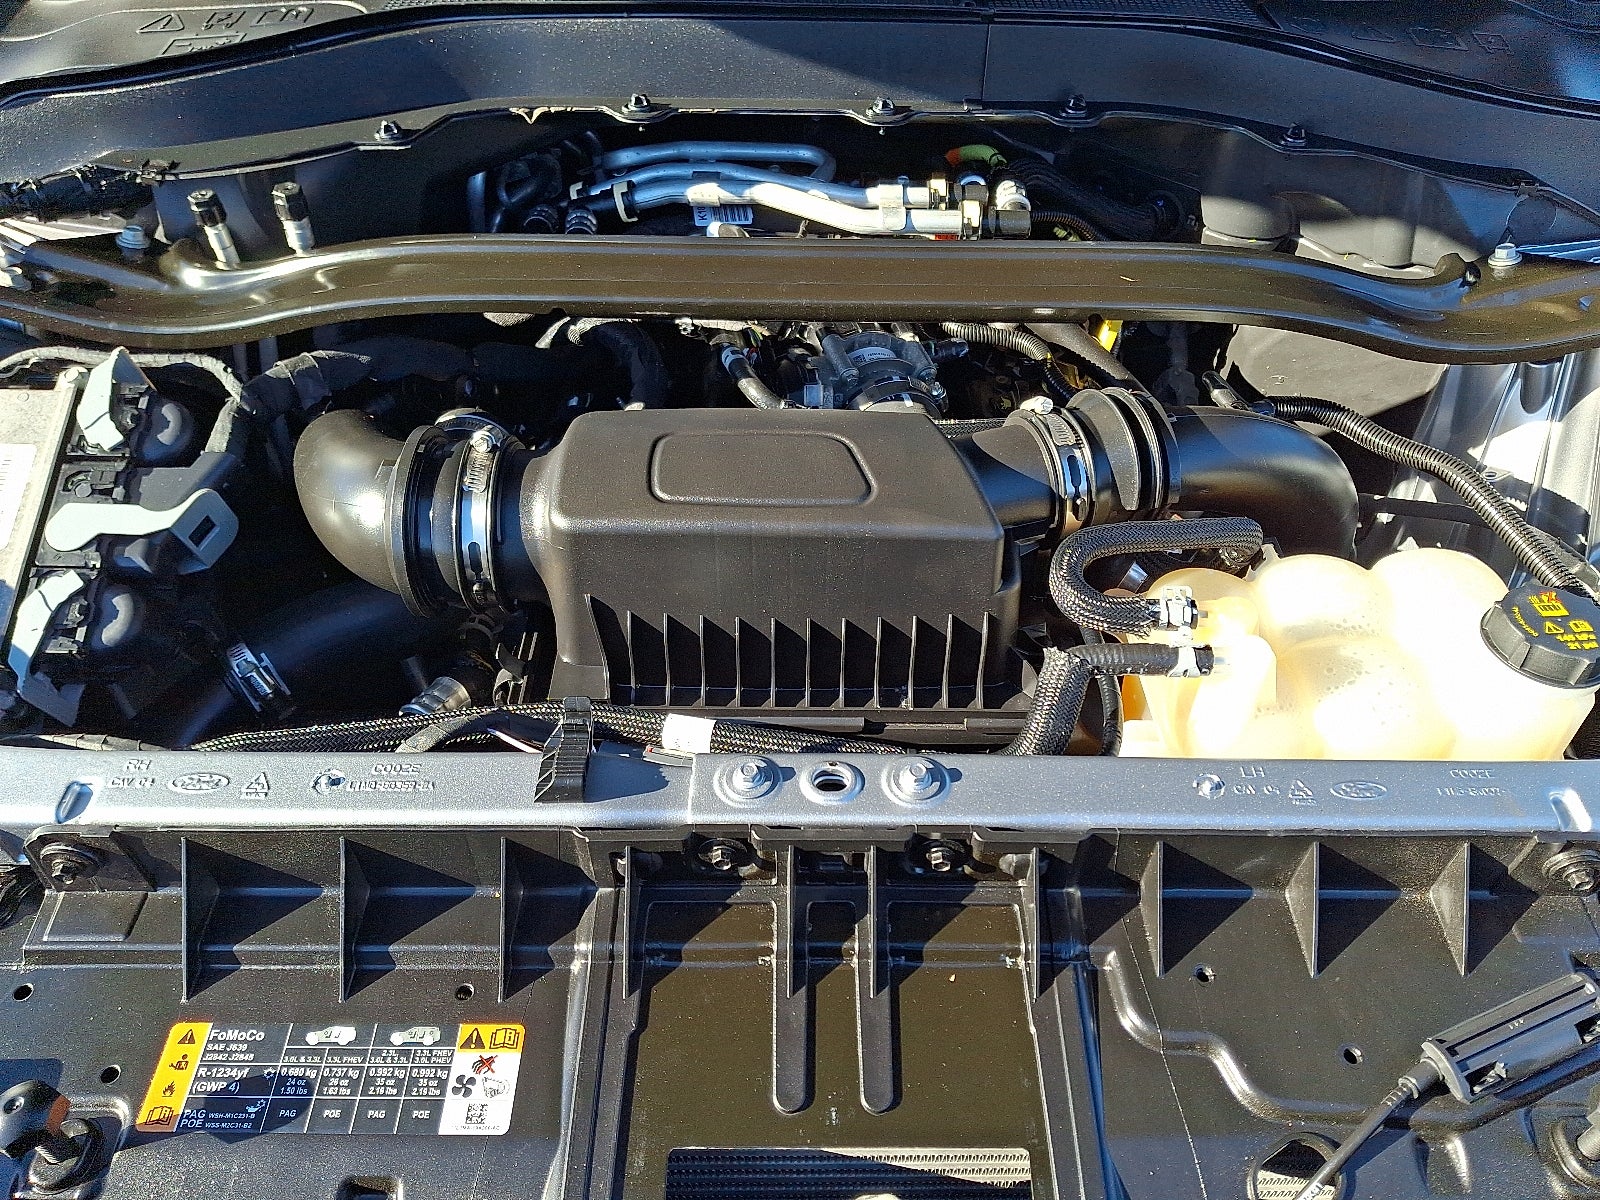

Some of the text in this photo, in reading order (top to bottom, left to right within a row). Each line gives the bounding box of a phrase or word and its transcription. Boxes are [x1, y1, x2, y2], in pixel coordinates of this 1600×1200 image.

[1240, 766, 1265, 778] LH
[209, 1029, 265, 1041] FoMoCo
[206, 1043, 248, 1051] SAE J639
[197, 1067, 250, 1080] R-1234yf
[281, 1067, 318, 1078] 0.680 kg
[323, 1067, 360, 1079] 0.737 kg
[369, 1068, 406, 1079] 0.992 kg
[411, 1069, 449, 1080] 0.992 kg
[286, 1078, 296, 1086] 24
[375, 1078, 385, 1086] 35
[417, 1079, 428, 1087] 35
[192, 1082, 240, 1094] (GWP 4)
[280, 1087, 308, 1095] 1.50 lbs
[339, 1087, 352, 1096] lbs
[183, 1110, 207, 1119] PAG
[279, 1110, 297, 1118] PAG
[323, 1110, 341, 1118] POE
[367, 1110, 386, 1119] PAG
[412, 1110, 431, 1119] POE
[179, 1119, 204, 1128] POE
